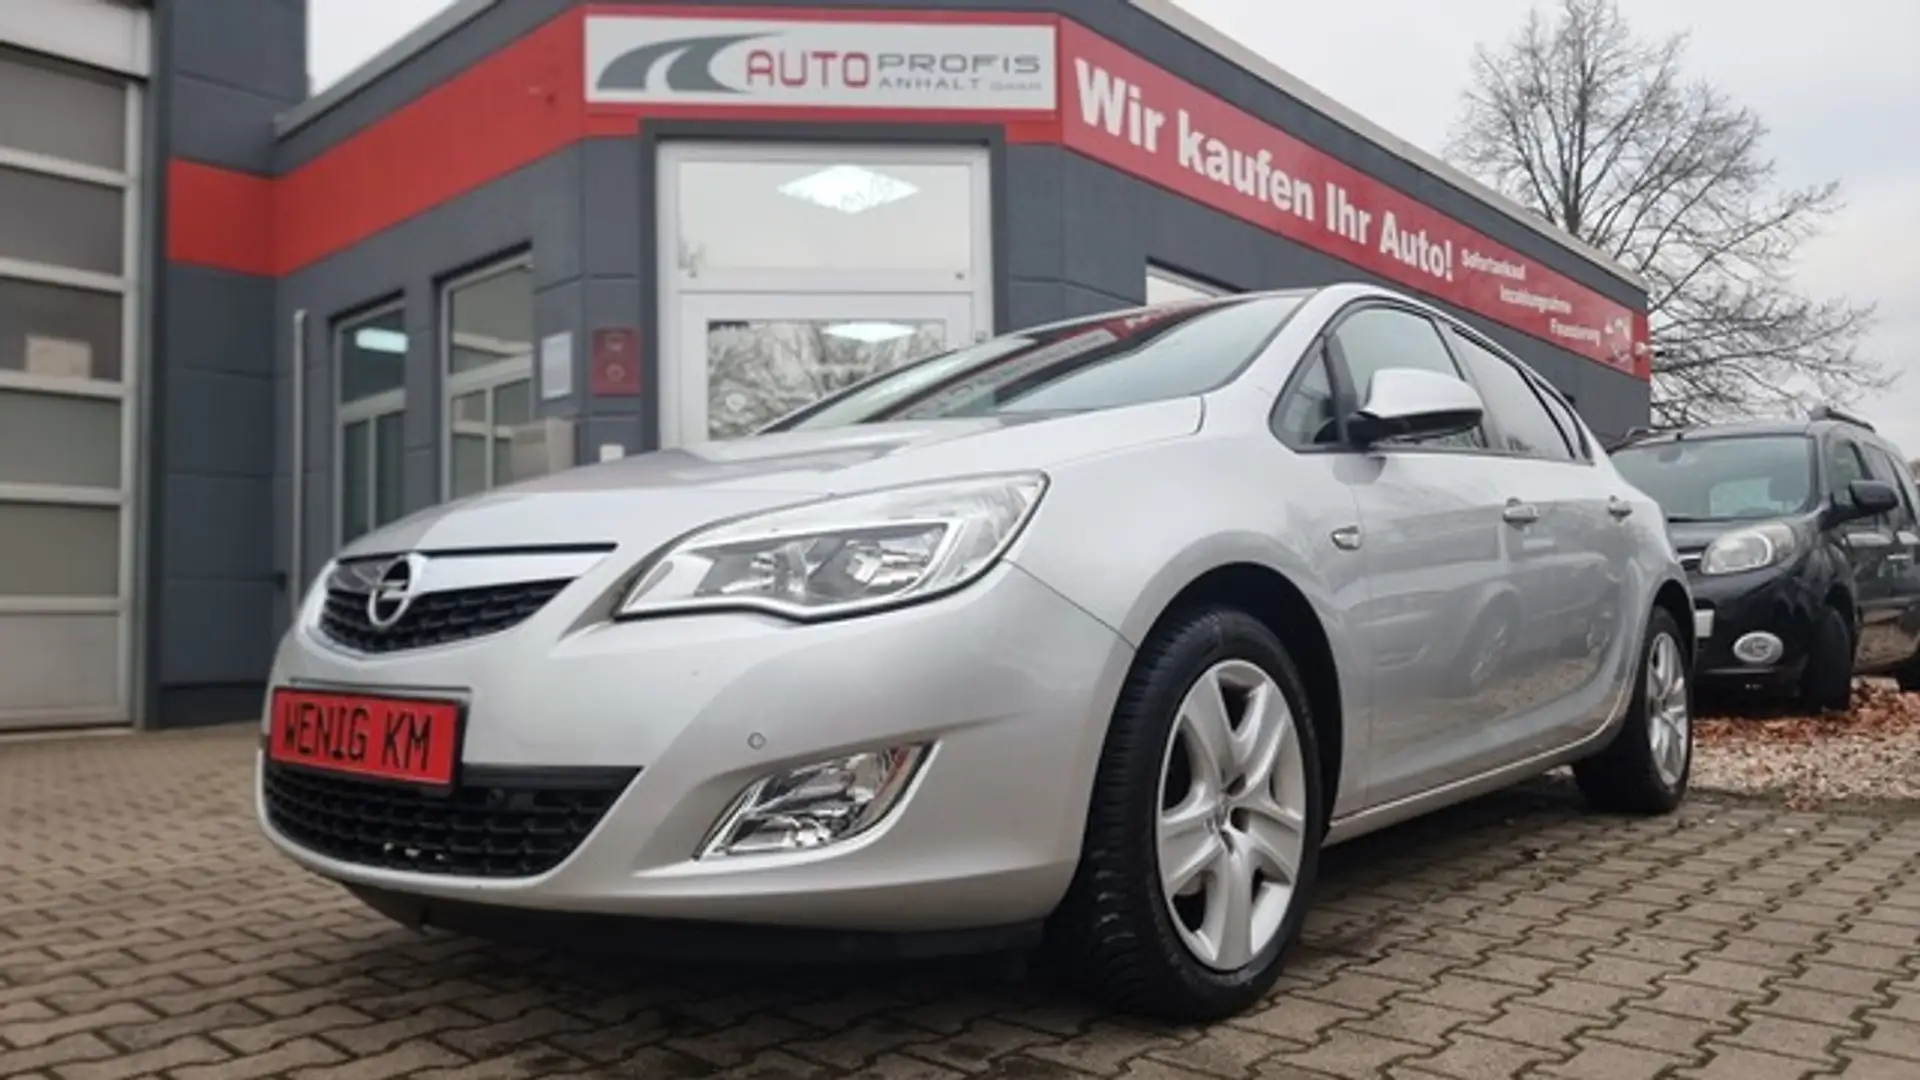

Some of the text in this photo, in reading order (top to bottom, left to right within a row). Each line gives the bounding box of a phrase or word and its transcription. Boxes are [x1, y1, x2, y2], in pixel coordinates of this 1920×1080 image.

[745, 49, 1041, 88] AUTO PROFIS
[878, 77, 981, 91] ANHALT
[1074, 57, 1453, 281] Wir kaufen Ihr Auto!
[285, 703, 432, 770] WENIG KM
